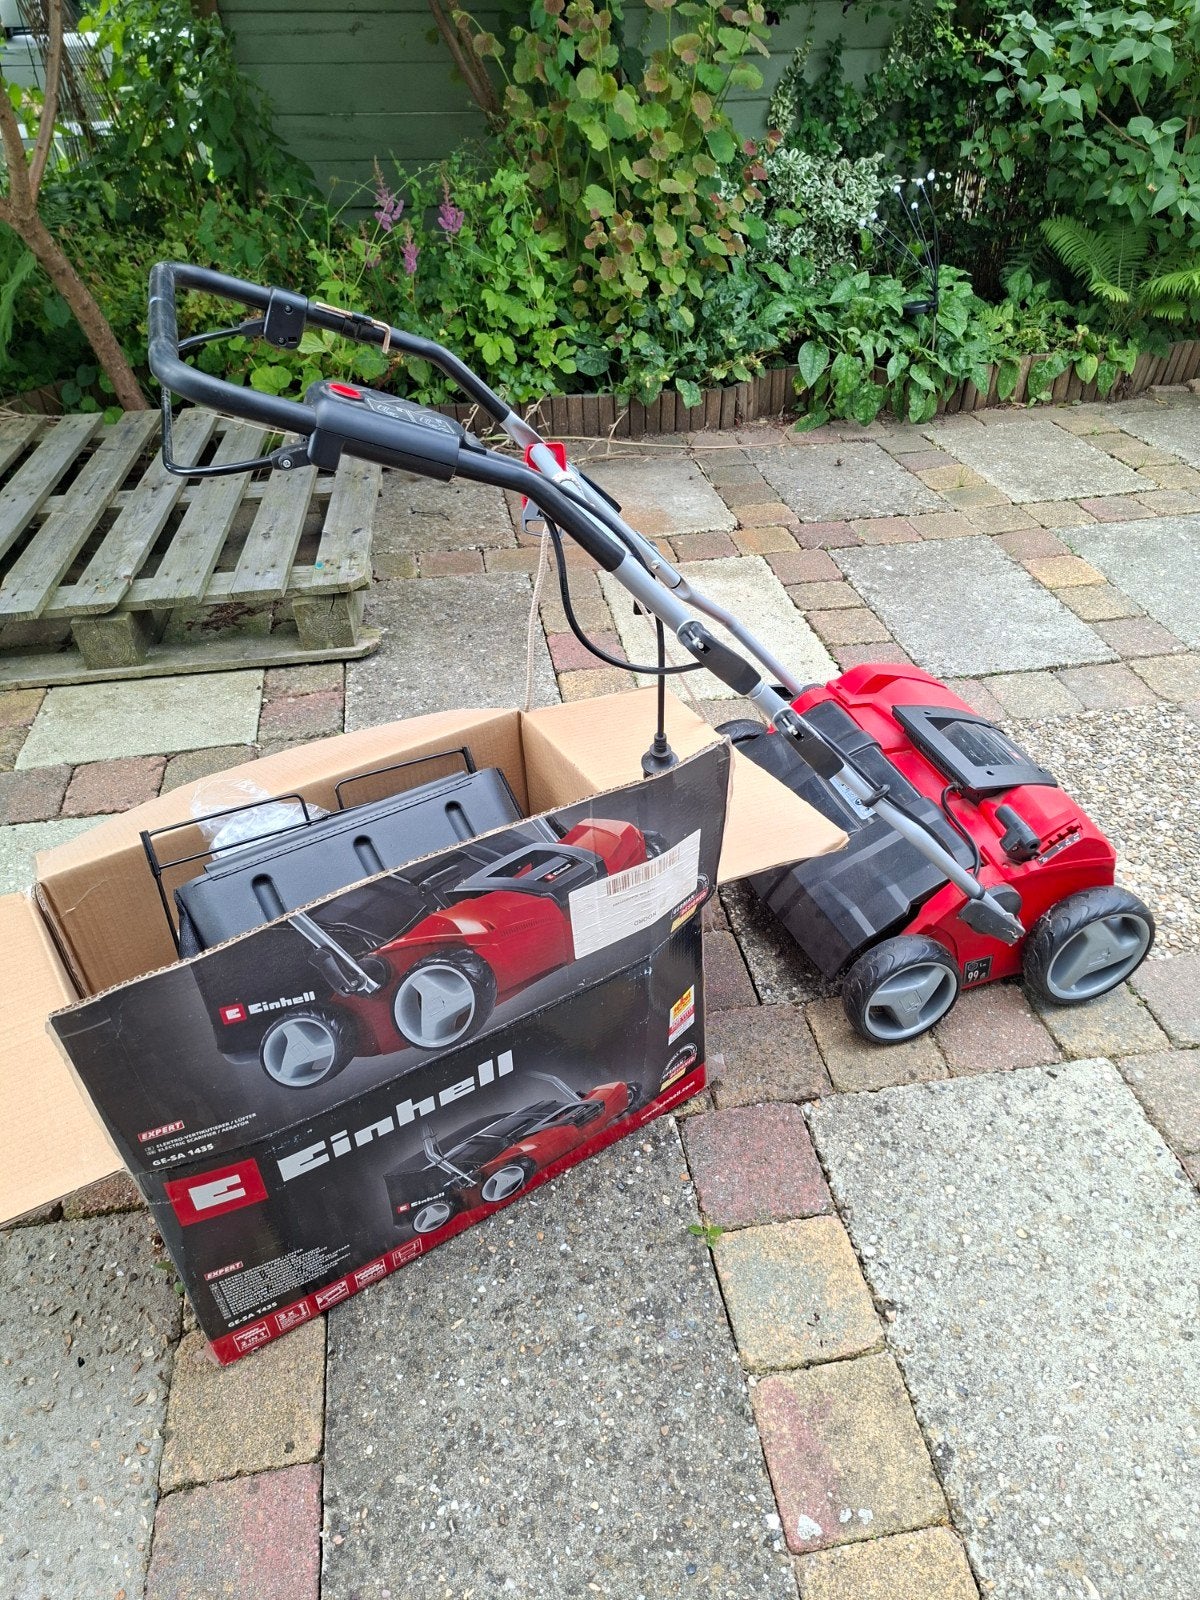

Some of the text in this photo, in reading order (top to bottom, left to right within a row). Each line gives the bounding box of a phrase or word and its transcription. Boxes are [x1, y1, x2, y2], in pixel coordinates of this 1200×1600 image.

[248, 991, 316, 1014] Einhell
[277, 1049, 514, 1182] Einhell
[141, 1121, 182, 1140] EXPERT
[158, 1141, 186, 1152] ELECTRIC
[186, 1131, 217, 1144] SCARIFIER
[221, 1120, 250, 1132] AERATOR
[152, 1143, 215, 1166] GE-SA 1435
[207, 1263, 241, 1280] EXPERT
[228, 1302, 278, 1328] GE-SA 1435
